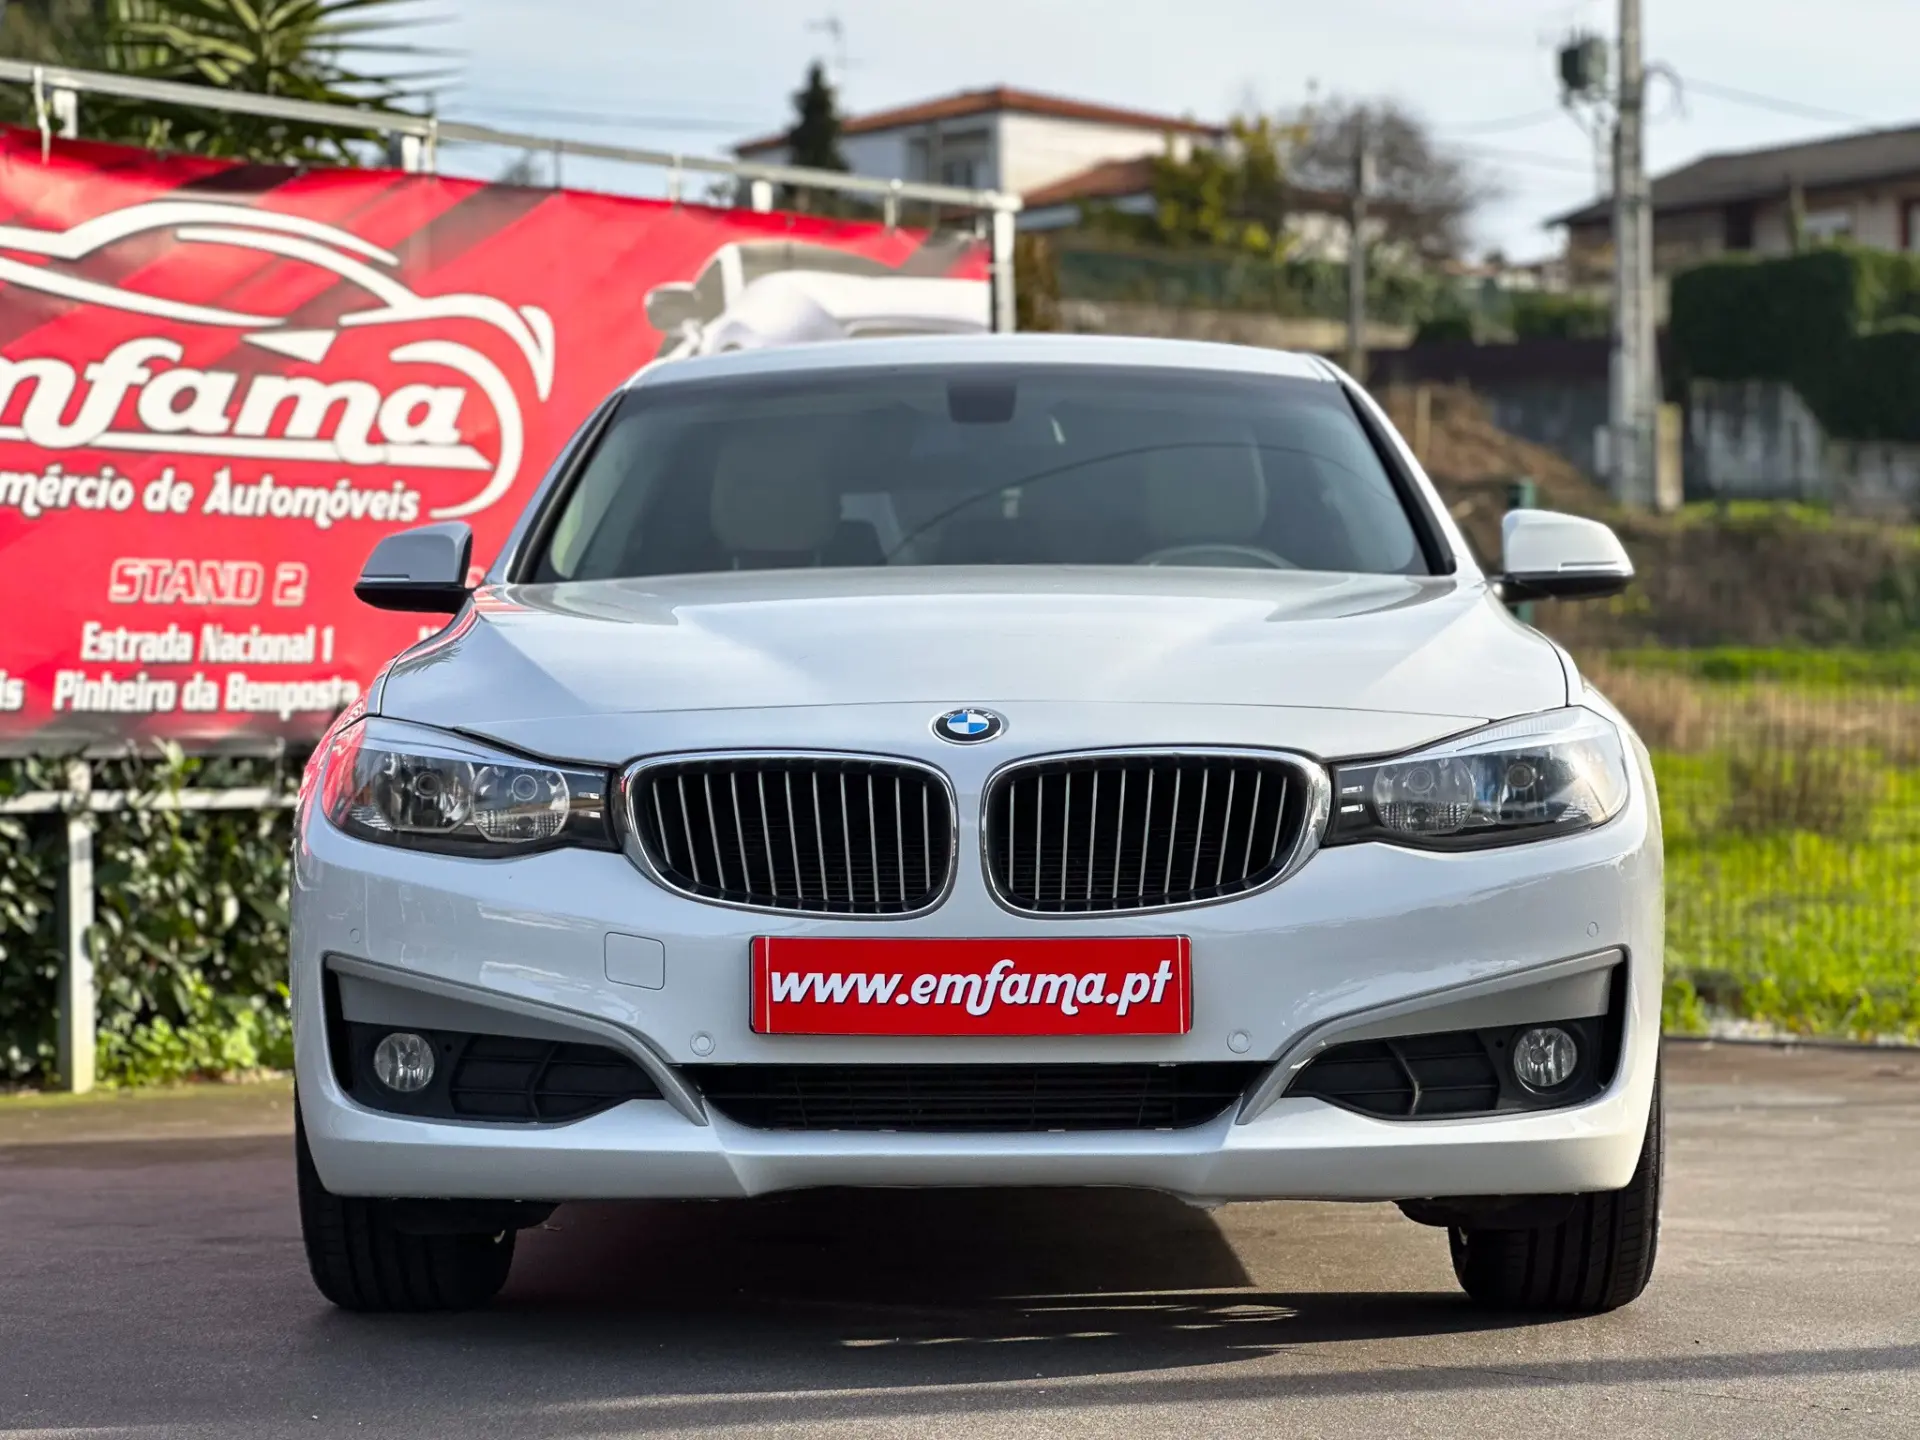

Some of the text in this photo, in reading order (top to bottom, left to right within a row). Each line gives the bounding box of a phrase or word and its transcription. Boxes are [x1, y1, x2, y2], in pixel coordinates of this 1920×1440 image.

[143, 467, 194, 513] de
[203, 467, 420, 529] Automóveis
[108, 557, 307, 606] STAND 2
[81, 622, 193, 662] Estrada
[201, 625, 315, 664] Nacional
[53, 671, 360, 720] Pinheiro da Bemposta
[771, 959, 1172, 1016] www.emfama.pt
